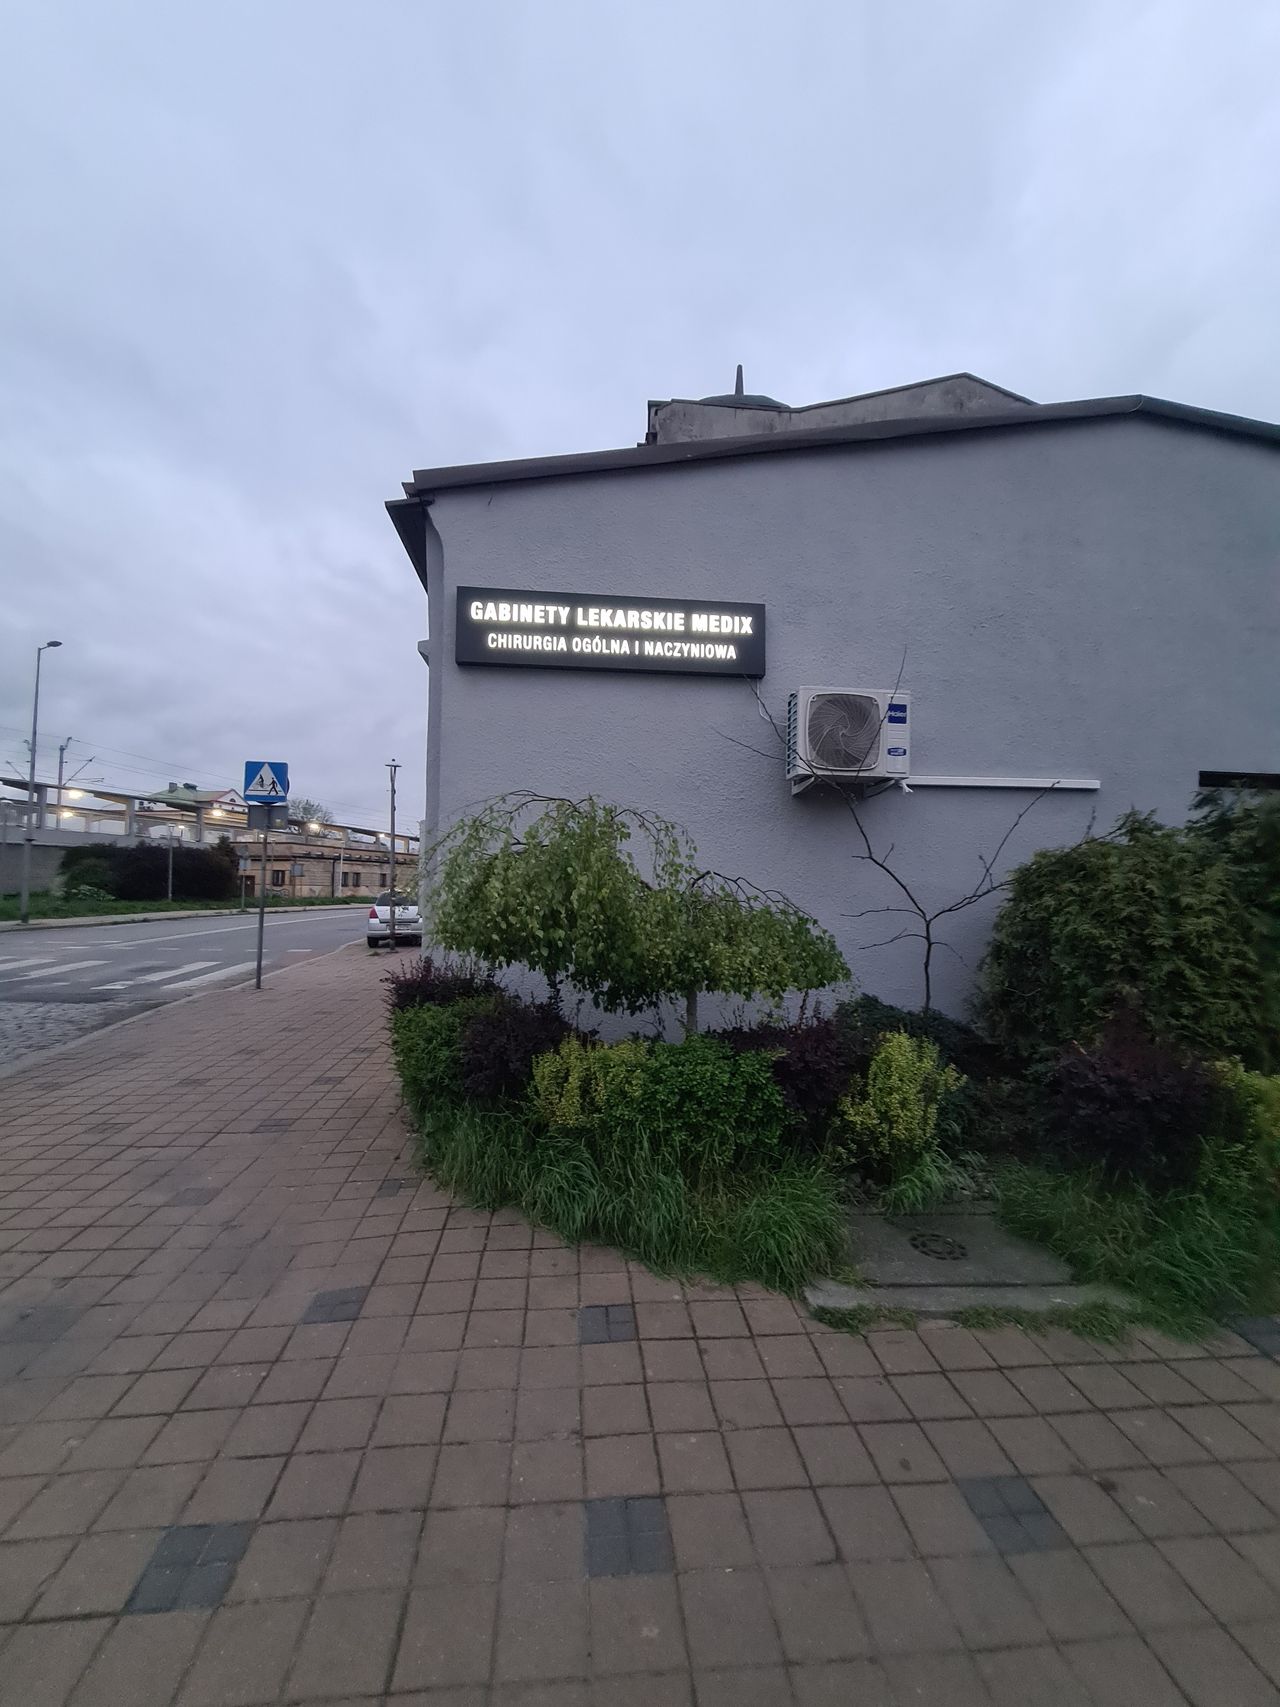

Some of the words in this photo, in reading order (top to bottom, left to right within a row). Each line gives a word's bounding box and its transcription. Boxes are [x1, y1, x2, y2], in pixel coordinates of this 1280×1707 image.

[470, 601, 571, 625] GABINETY
[577, 607, 685, 632] LEKARSKIE
[691, 613, 754, 635] MEDIX
[487, 632, 568, 652] CHIRURGIA
[571, 635, 631, 655] OGÓLNA
[634, 640, 640, 656] I
[644, 641, 738, 661] NACZYNIOWA
